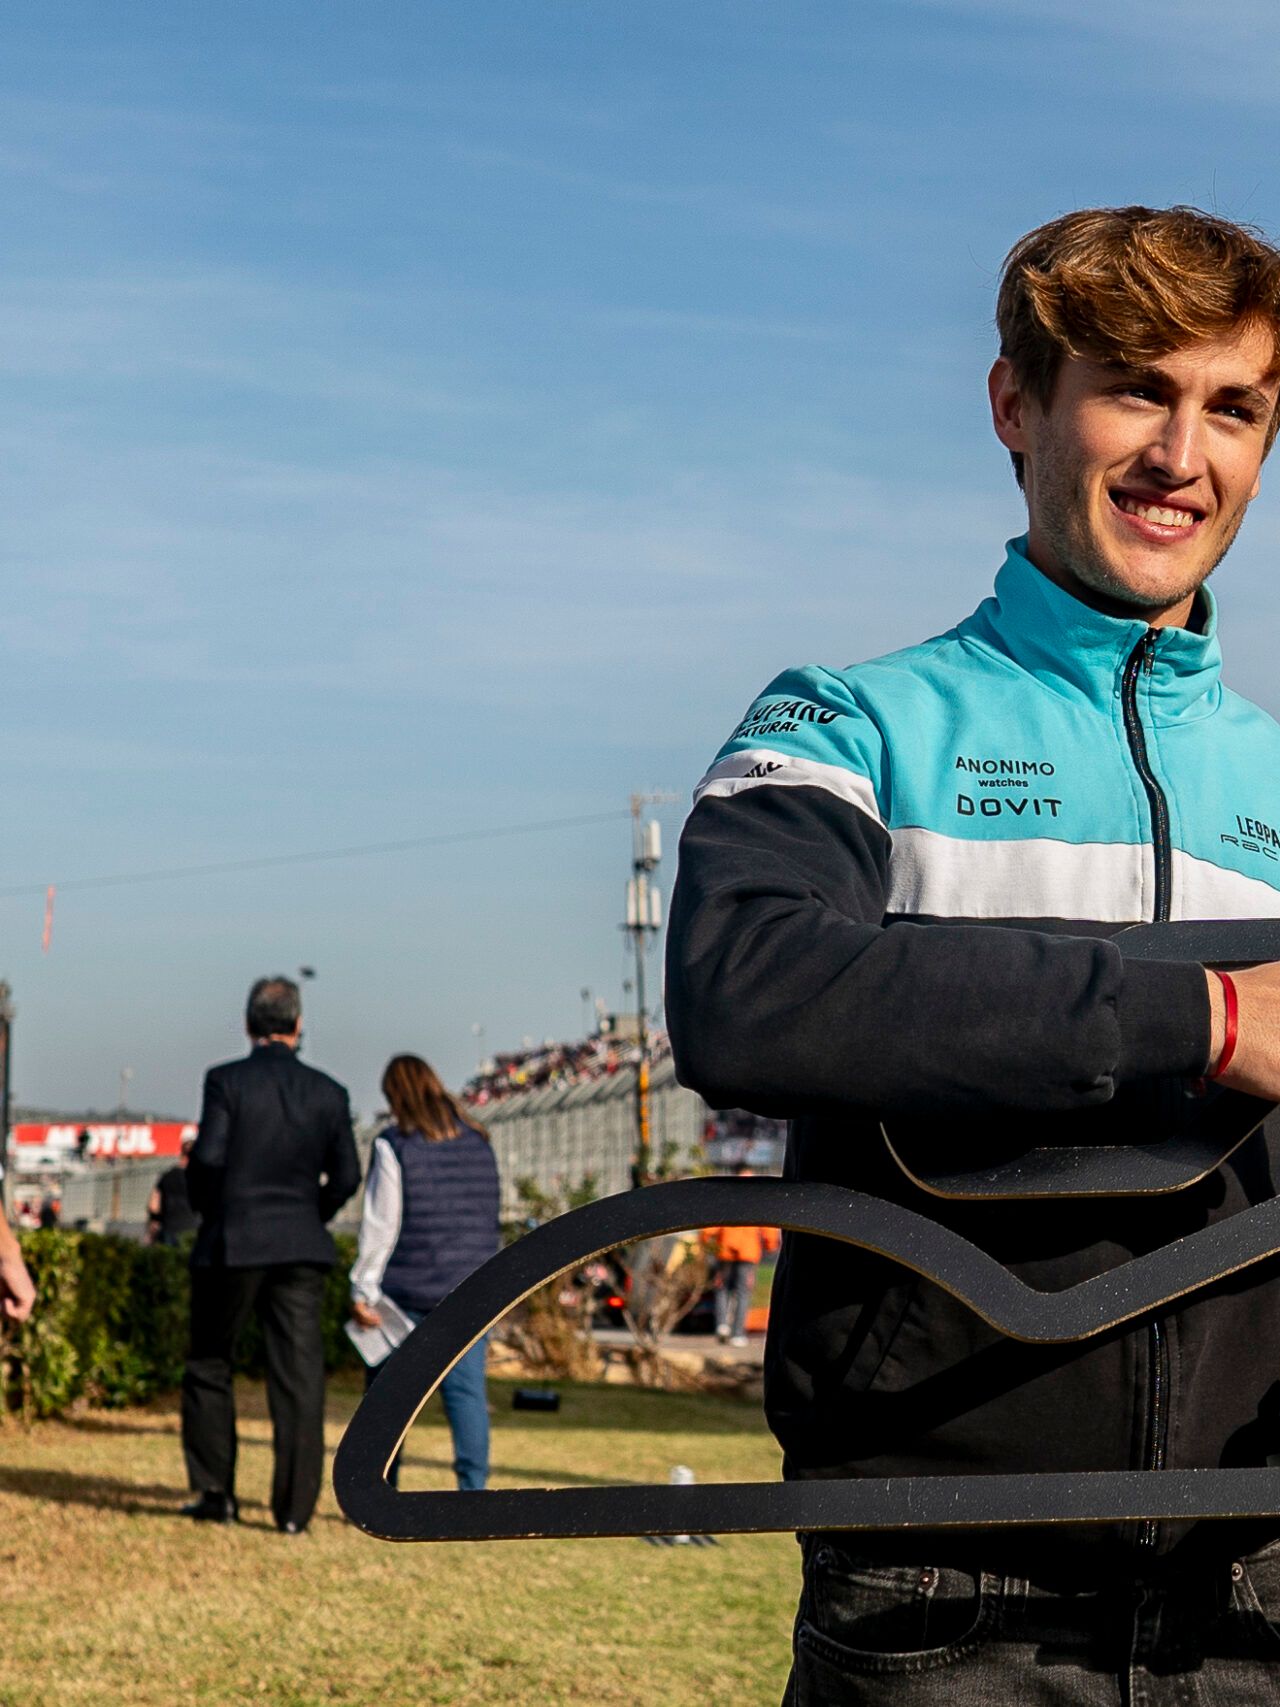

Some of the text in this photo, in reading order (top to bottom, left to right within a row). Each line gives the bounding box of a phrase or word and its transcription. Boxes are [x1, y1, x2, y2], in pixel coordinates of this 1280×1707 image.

[739, 701, 840, 729] OPARD
[955, 756, 1055, 776] ANONIMO
[978, 778, 1029, 787] watches
[956, 793, 1062, 817] DOVIT
